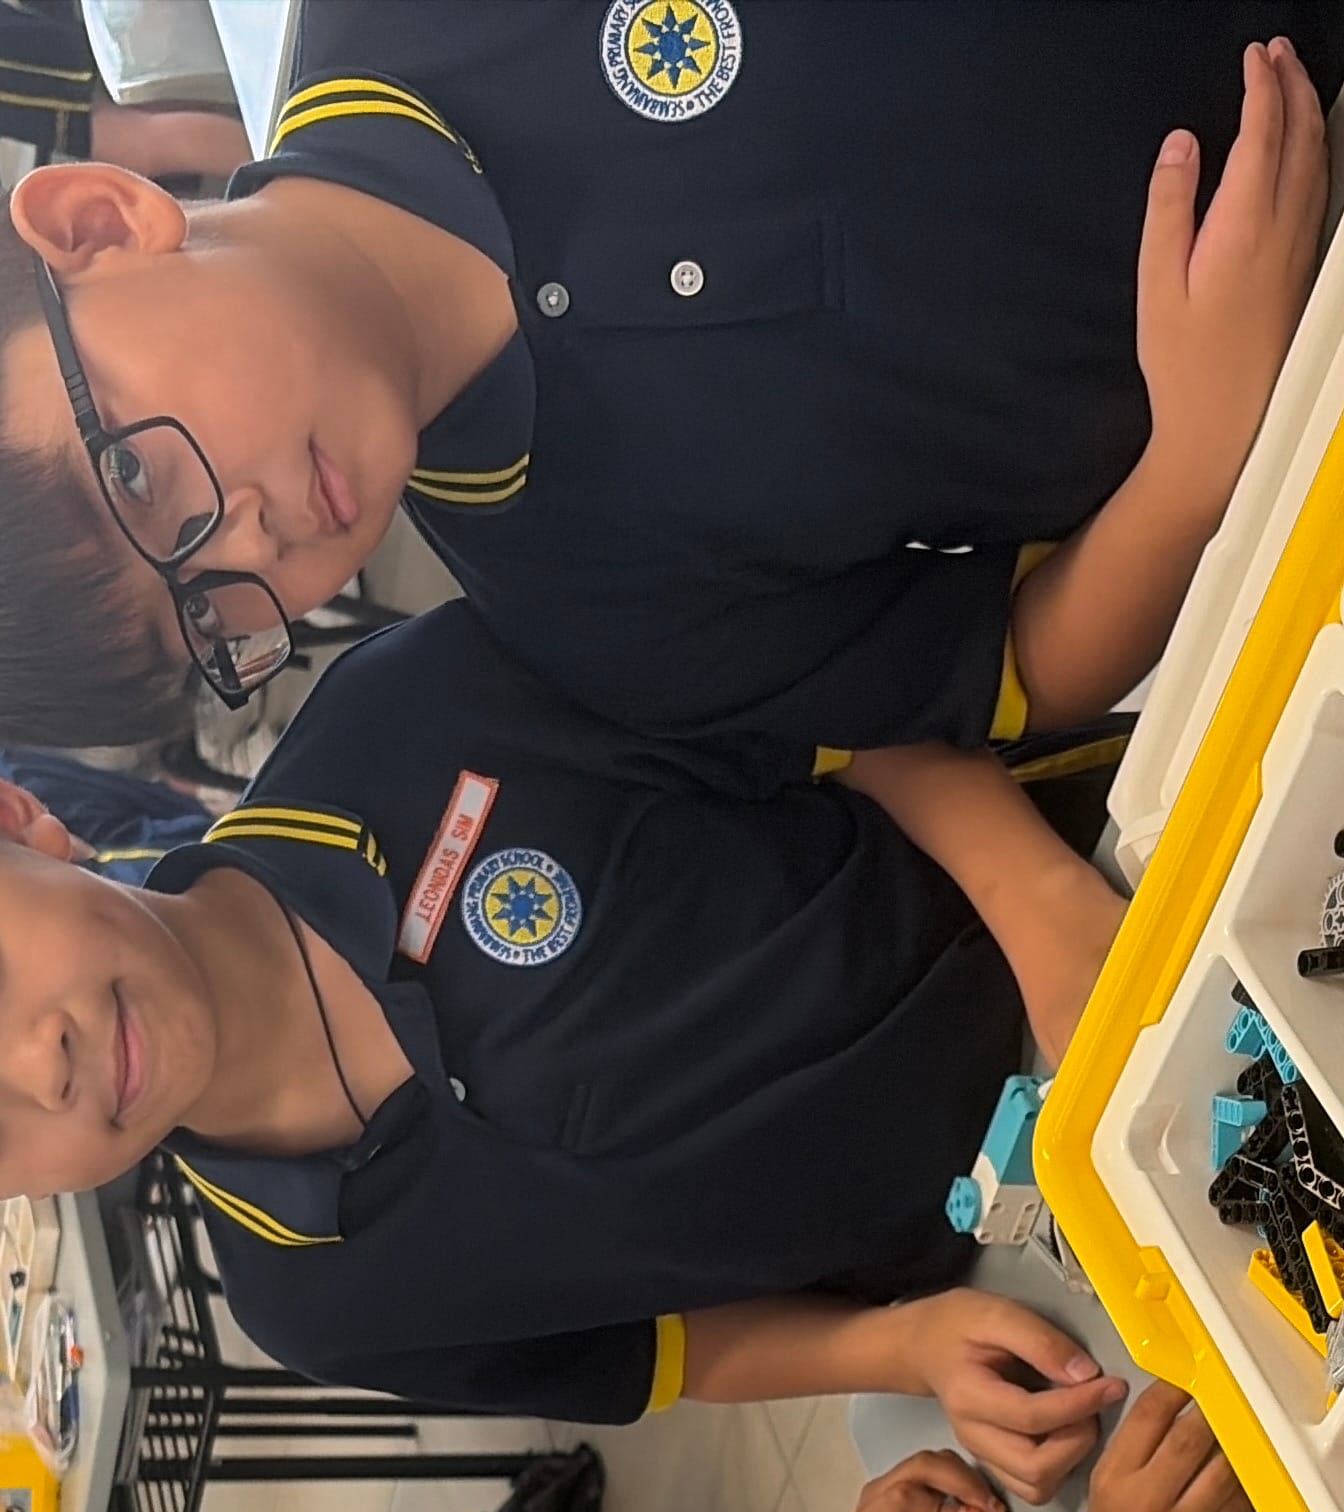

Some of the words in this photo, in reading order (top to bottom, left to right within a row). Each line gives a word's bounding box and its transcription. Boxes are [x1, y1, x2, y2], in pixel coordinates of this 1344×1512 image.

[607, 6, 628, 67] PRIMARY
[694, 78, 724, 108] THE
[716, 44, 736, 81] BEST
